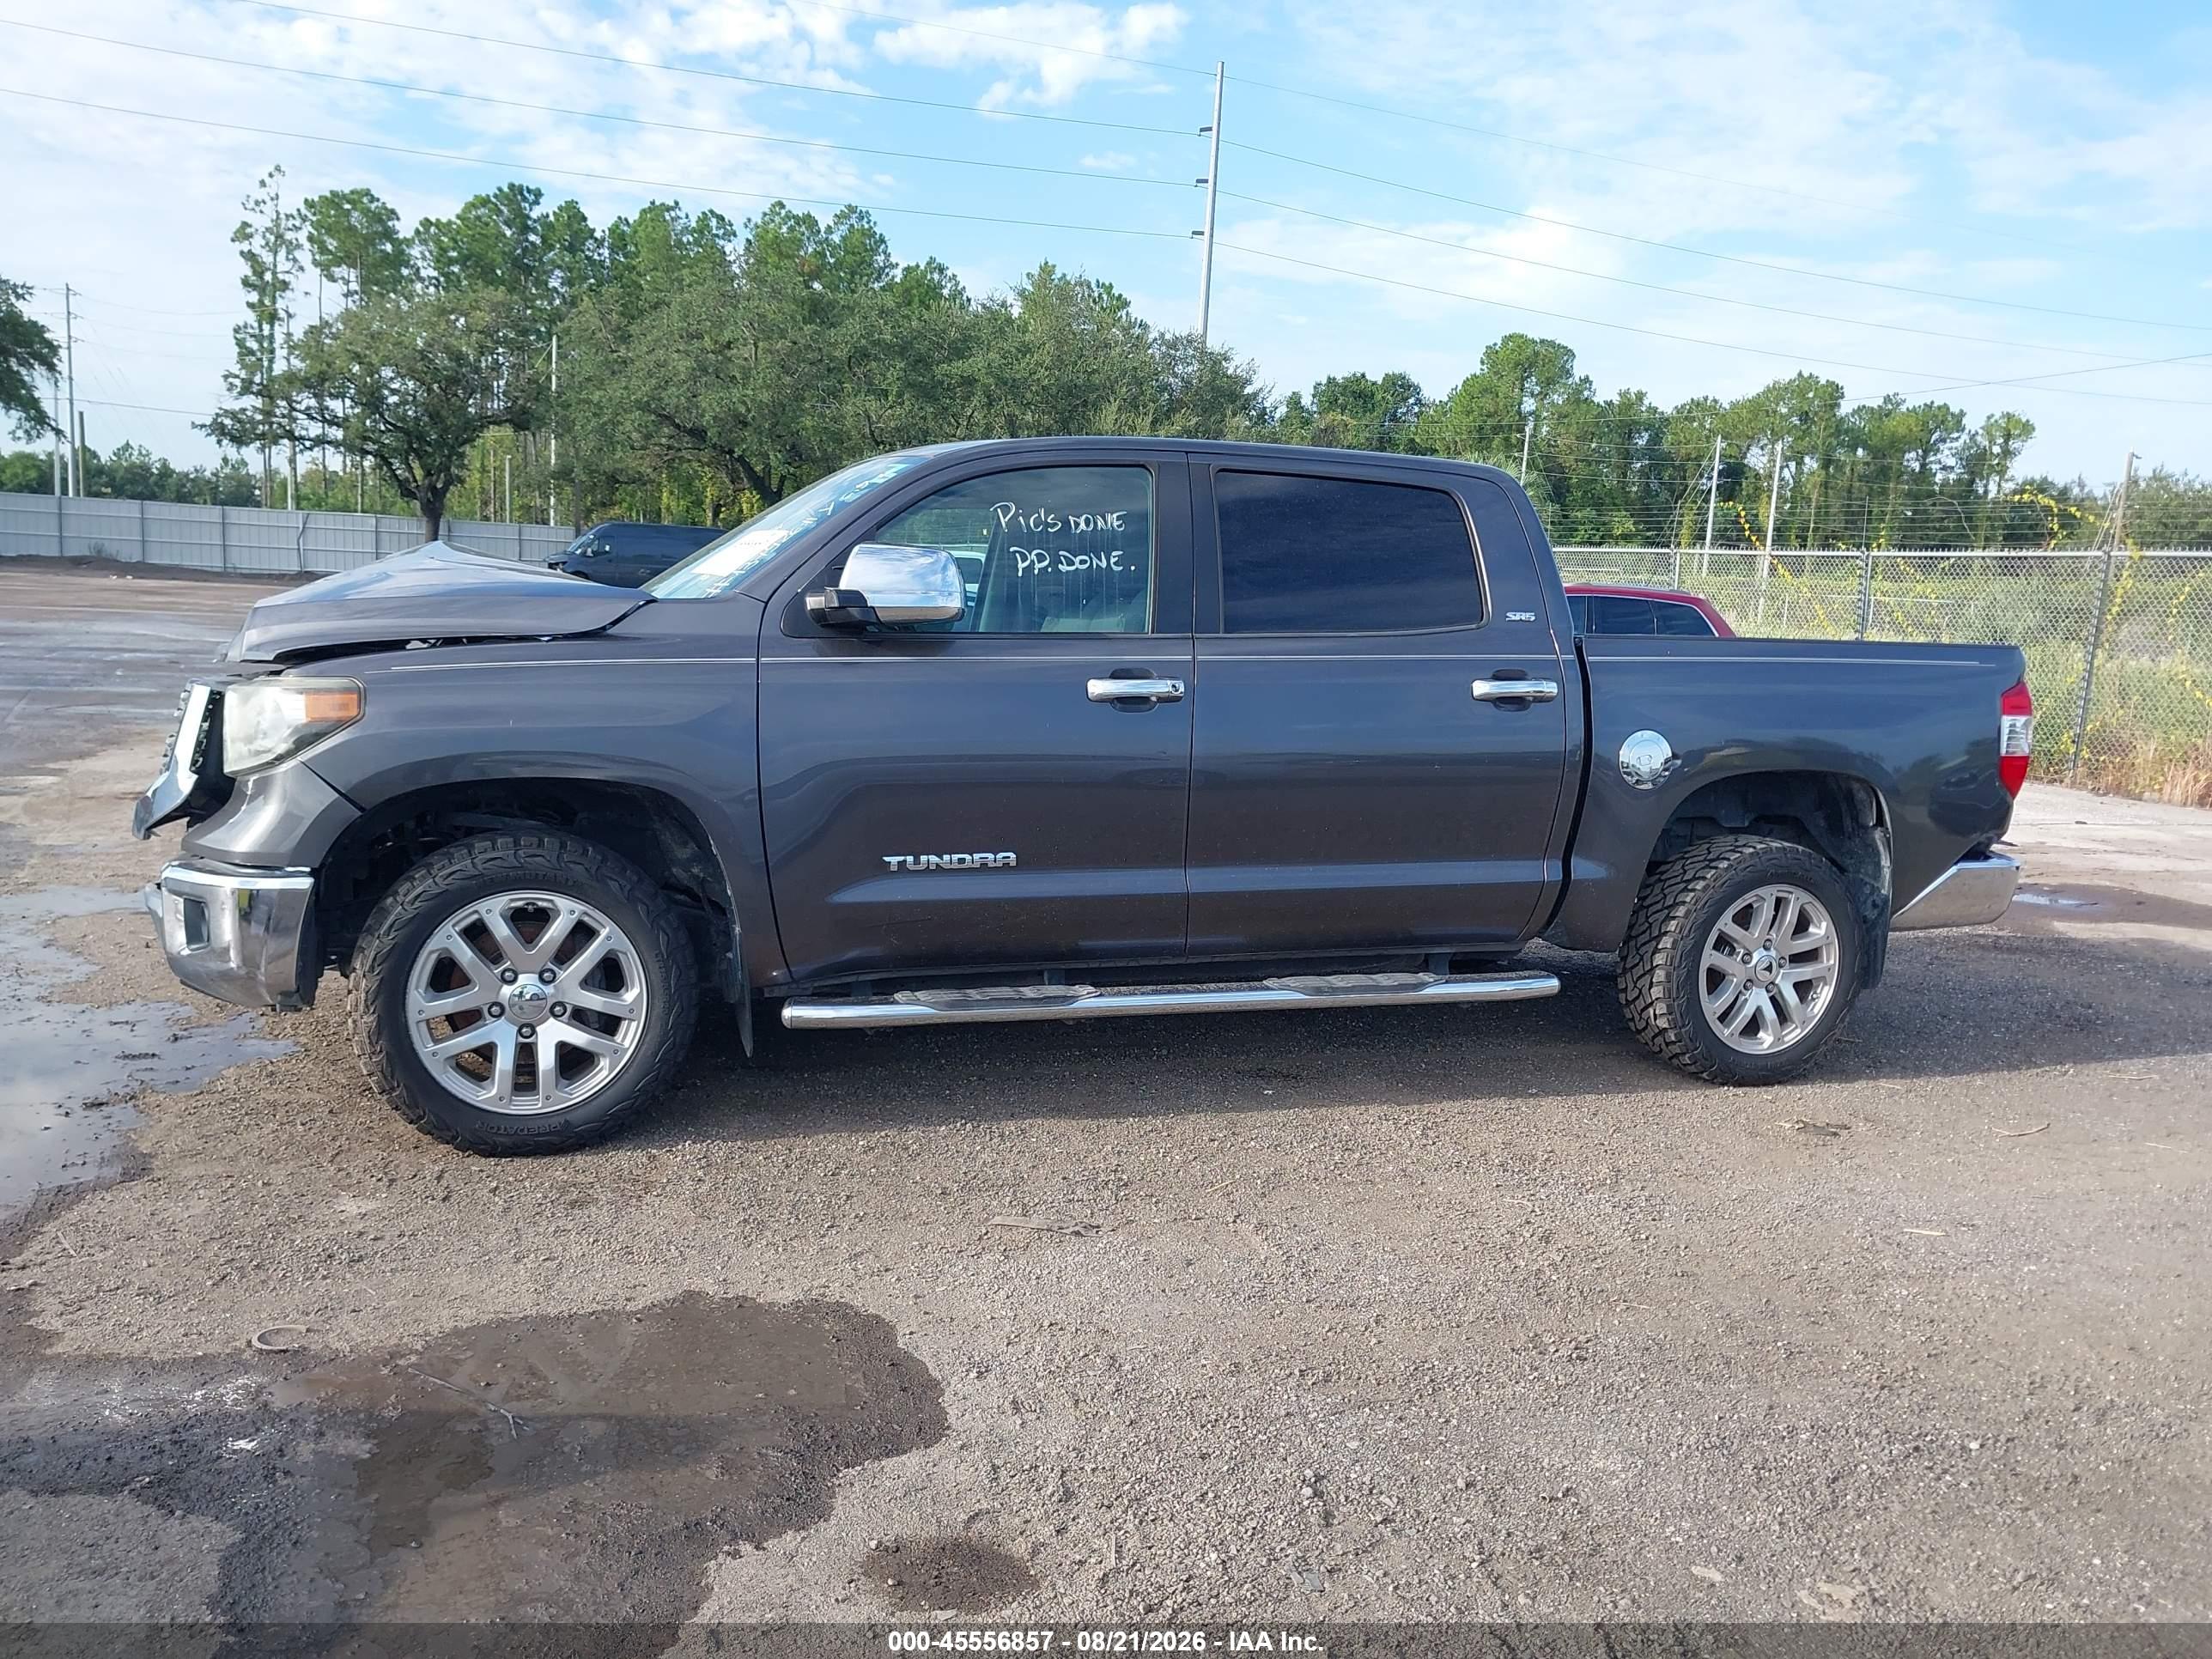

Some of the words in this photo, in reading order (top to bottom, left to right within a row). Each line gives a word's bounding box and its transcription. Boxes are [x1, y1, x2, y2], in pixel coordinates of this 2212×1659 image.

[1069, 511, 1127, 533] DONE
[1505, 611, 1536, 622] SR5
[882, 852, 1017, 872] TUNDRA
[475, 1120, 564, 1134] PREDATOR
